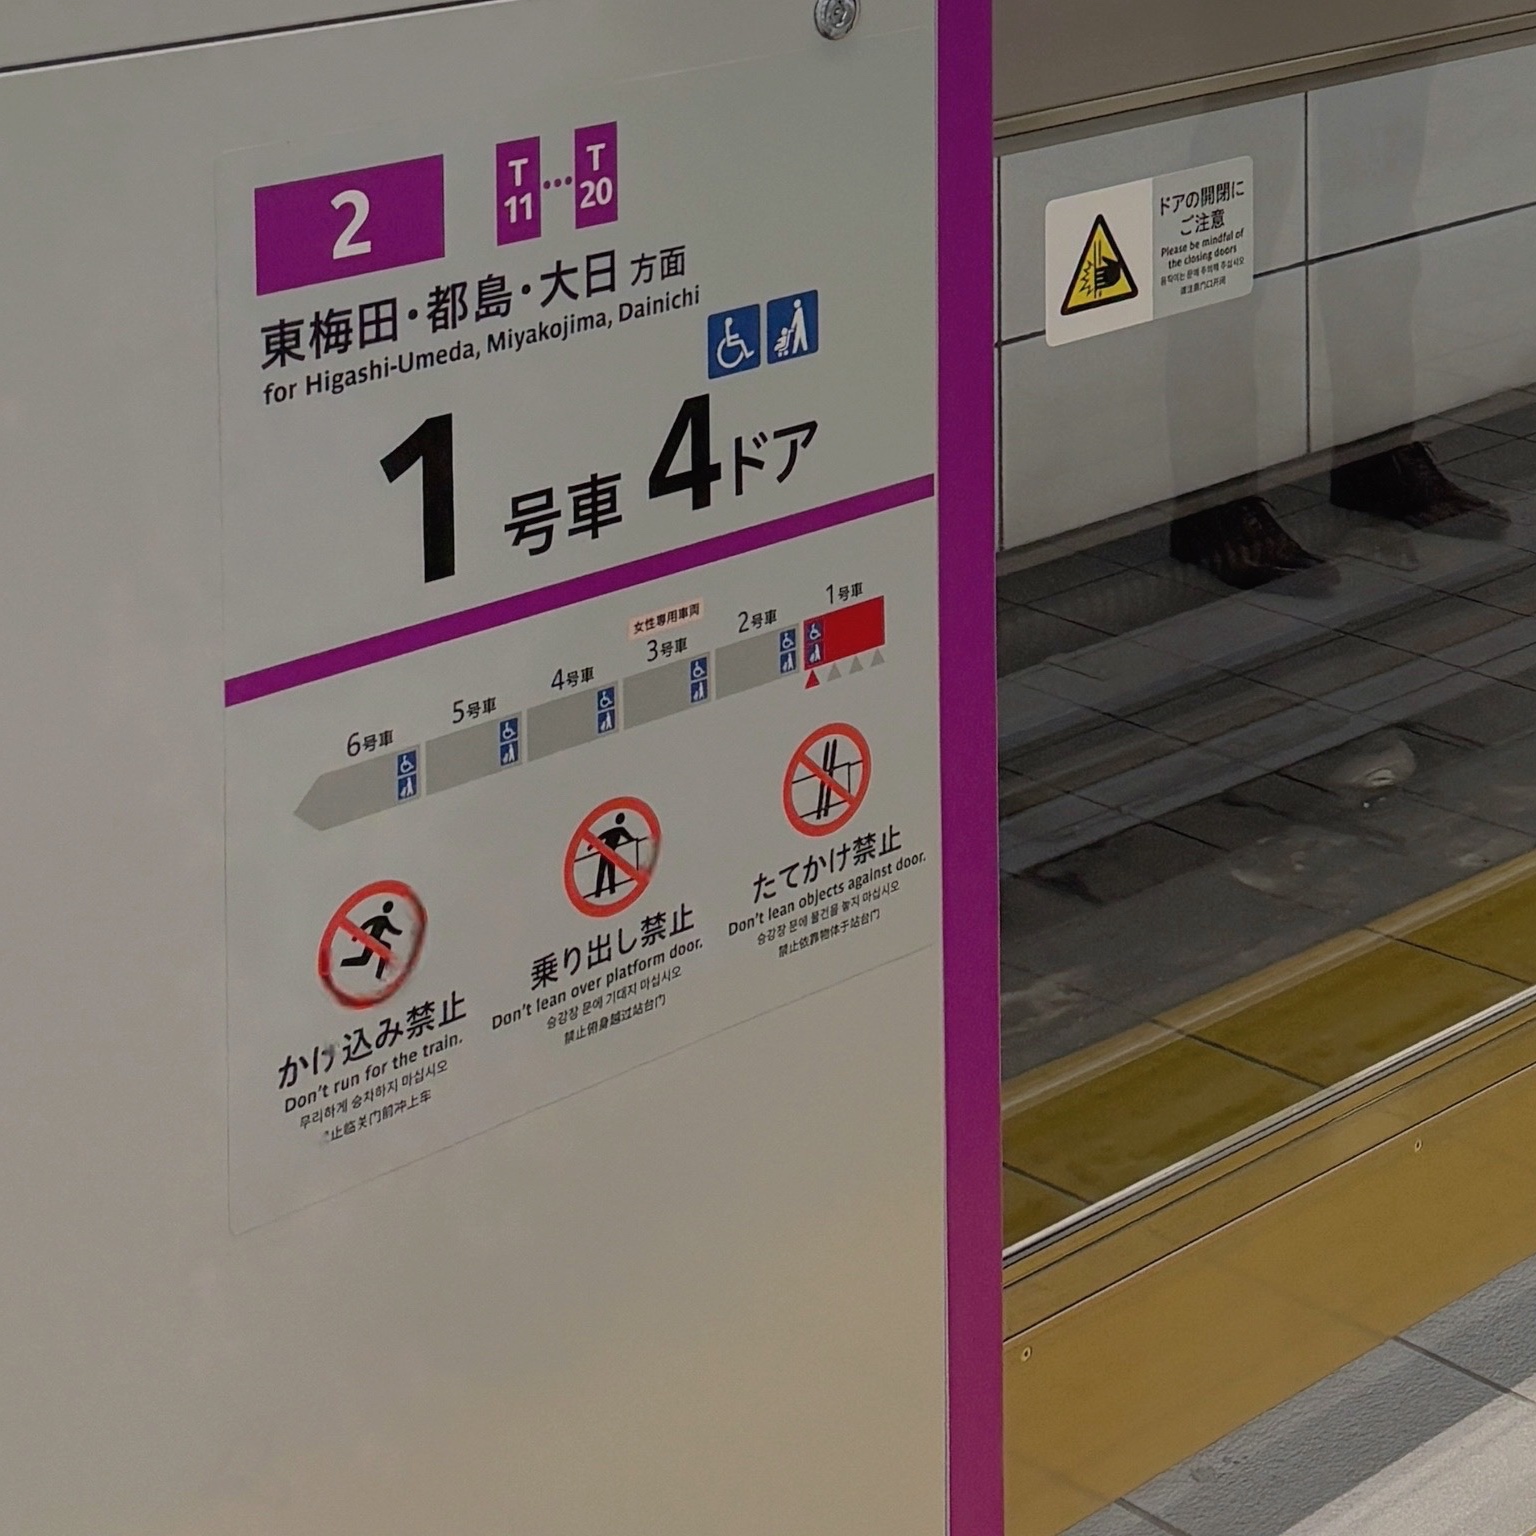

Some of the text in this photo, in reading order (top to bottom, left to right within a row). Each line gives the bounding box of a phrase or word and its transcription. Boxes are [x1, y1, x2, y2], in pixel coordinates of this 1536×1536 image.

[504, 157, 532, 224] T 11
[580, 142, 613, 209] T 20
[1161, 181, 1244, 216] ドアの開閉に
[330, 189, 371, 260] 2
[1161, 227, 1244, 257] Please be mindful of
[1181, 209, 1225, 236] ご注意
[1168, 244, 1237, 270] the closing doors
[260, 245, 686, 370] 東梅田・都島・大日 方面
[263, 285, 700, 405] for Higashi-Umeda, Miyakojima, Dainichi
[633, 602, 700, 635] 女性専用車両
[825, 582, 863, 604] 1号車
[738, 609, 777, 633] 2号車
[647, 637, 688, 662] 3号車
[551, 666, 594, 690] 4号車
[452, 697, 497, 724] 5号車
[347, 730, 394, 757] 6号車
[753, 824, 902, 904] たてかけ禁止
[728, 851, 926, 936] Don't lean objects against door.
[863, 880, 900, 903] 마십시오
[531, 903, 695, 991] 乗り出し禁止
[492, 938, 703, 1030] Don't lean over platform door.
[582, 996, 603, 1015] 문에
[606, 982, 637, 1005] 기대지
[641, 965, 682, 990] 마십시오
[278, 990, 467, 1089] かけ込み禁止
[284, 1034, 463, 1113] Don't run for the train.
[299, 1059, 448, 1129] 무리하게 승차하지 마십시오
[323, 1089, 432, 1142] 止临关门前冲上车
